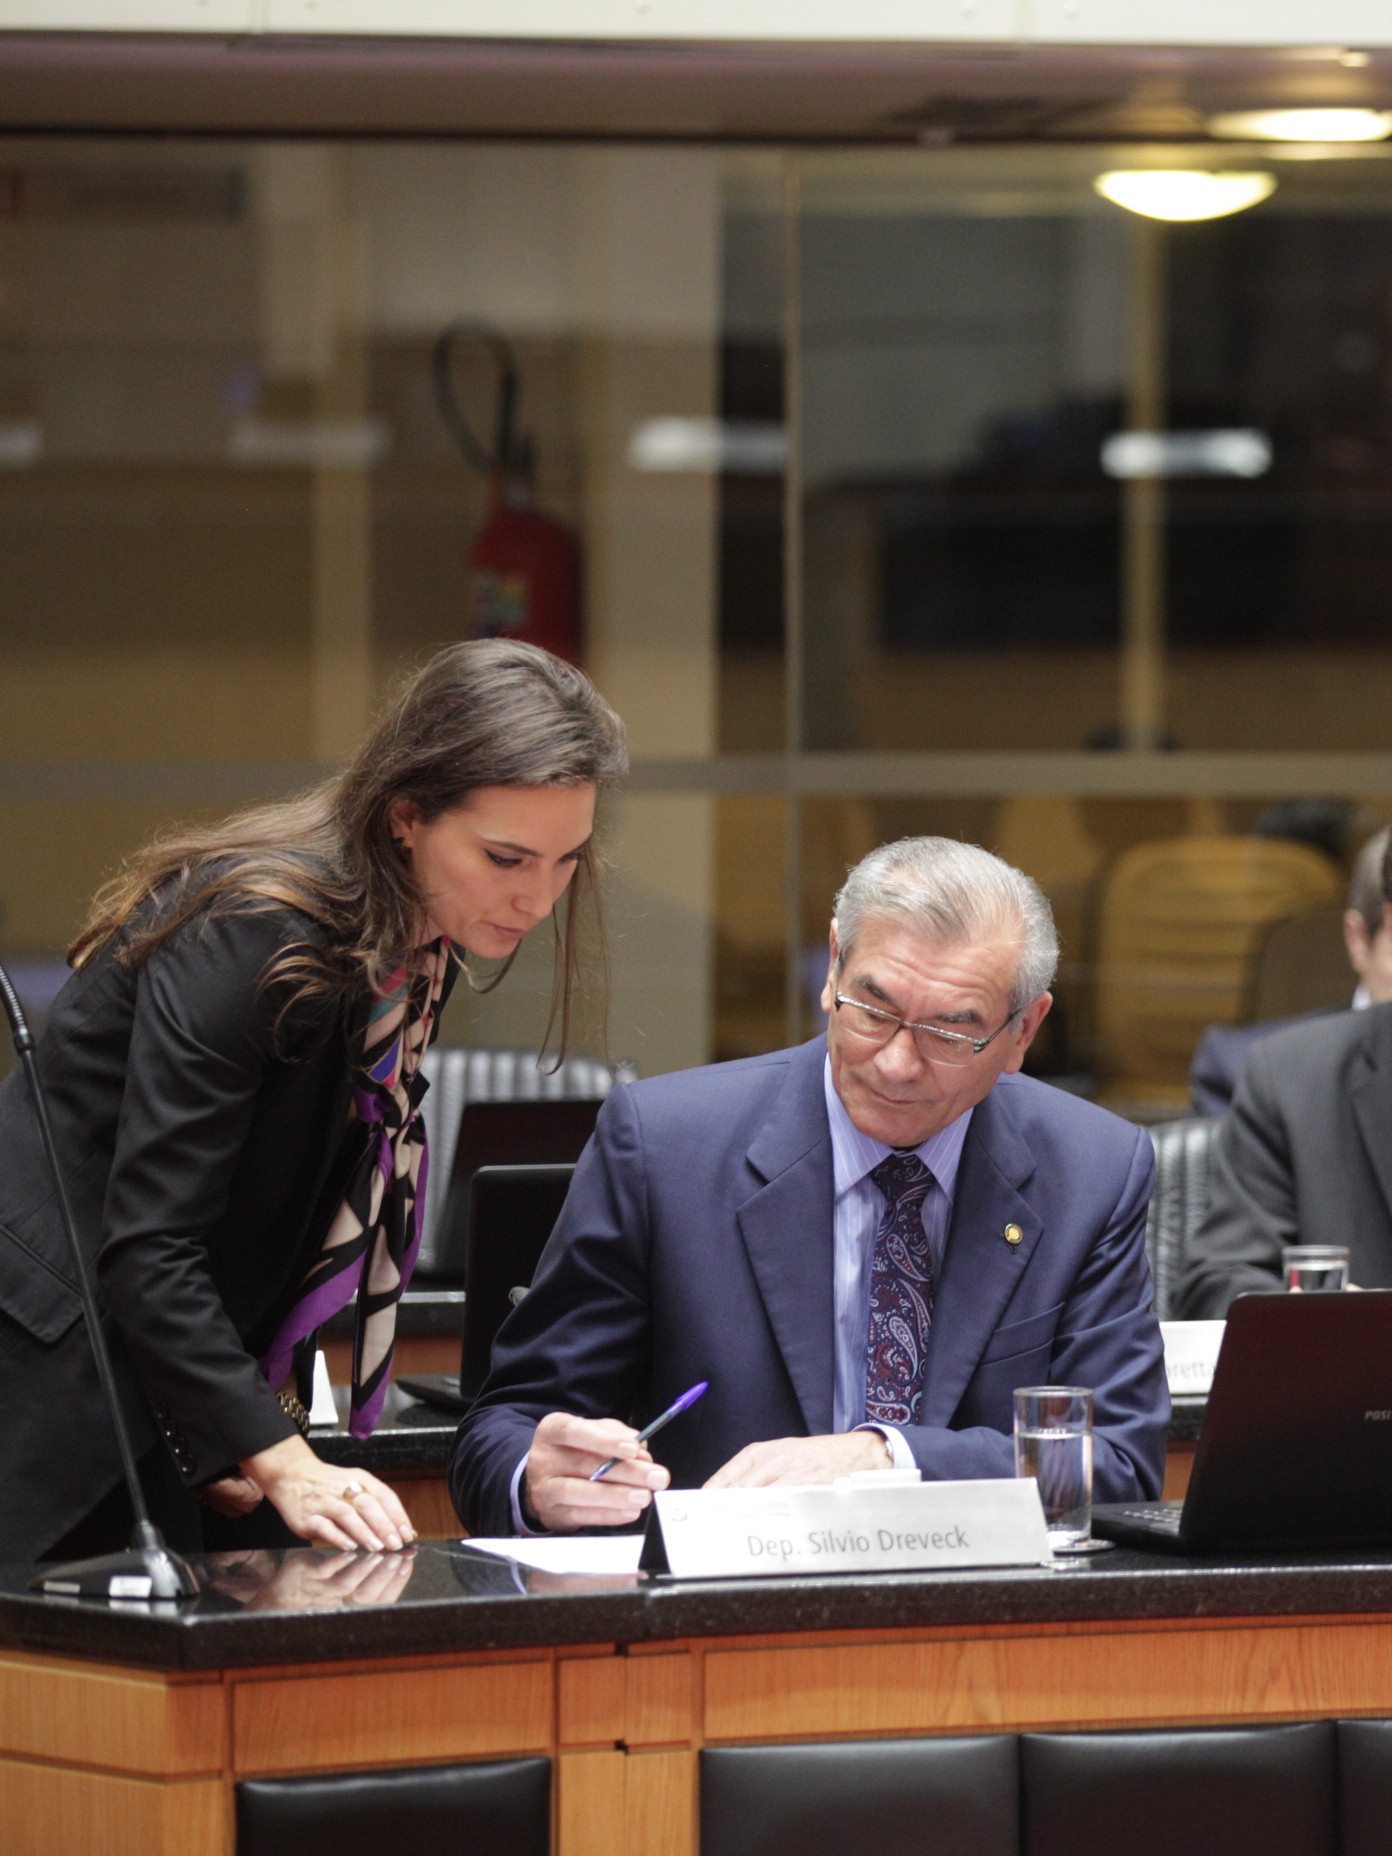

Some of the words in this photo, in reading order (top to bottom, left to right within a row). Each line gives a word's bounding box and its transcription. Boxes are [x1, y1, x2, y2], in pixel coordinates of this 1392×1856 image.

[747, 1535, 803, 1562] Dep.
[808, 1530, 871, 1554] Silvio
[877, 1525, 970, 1552] Dreveck
